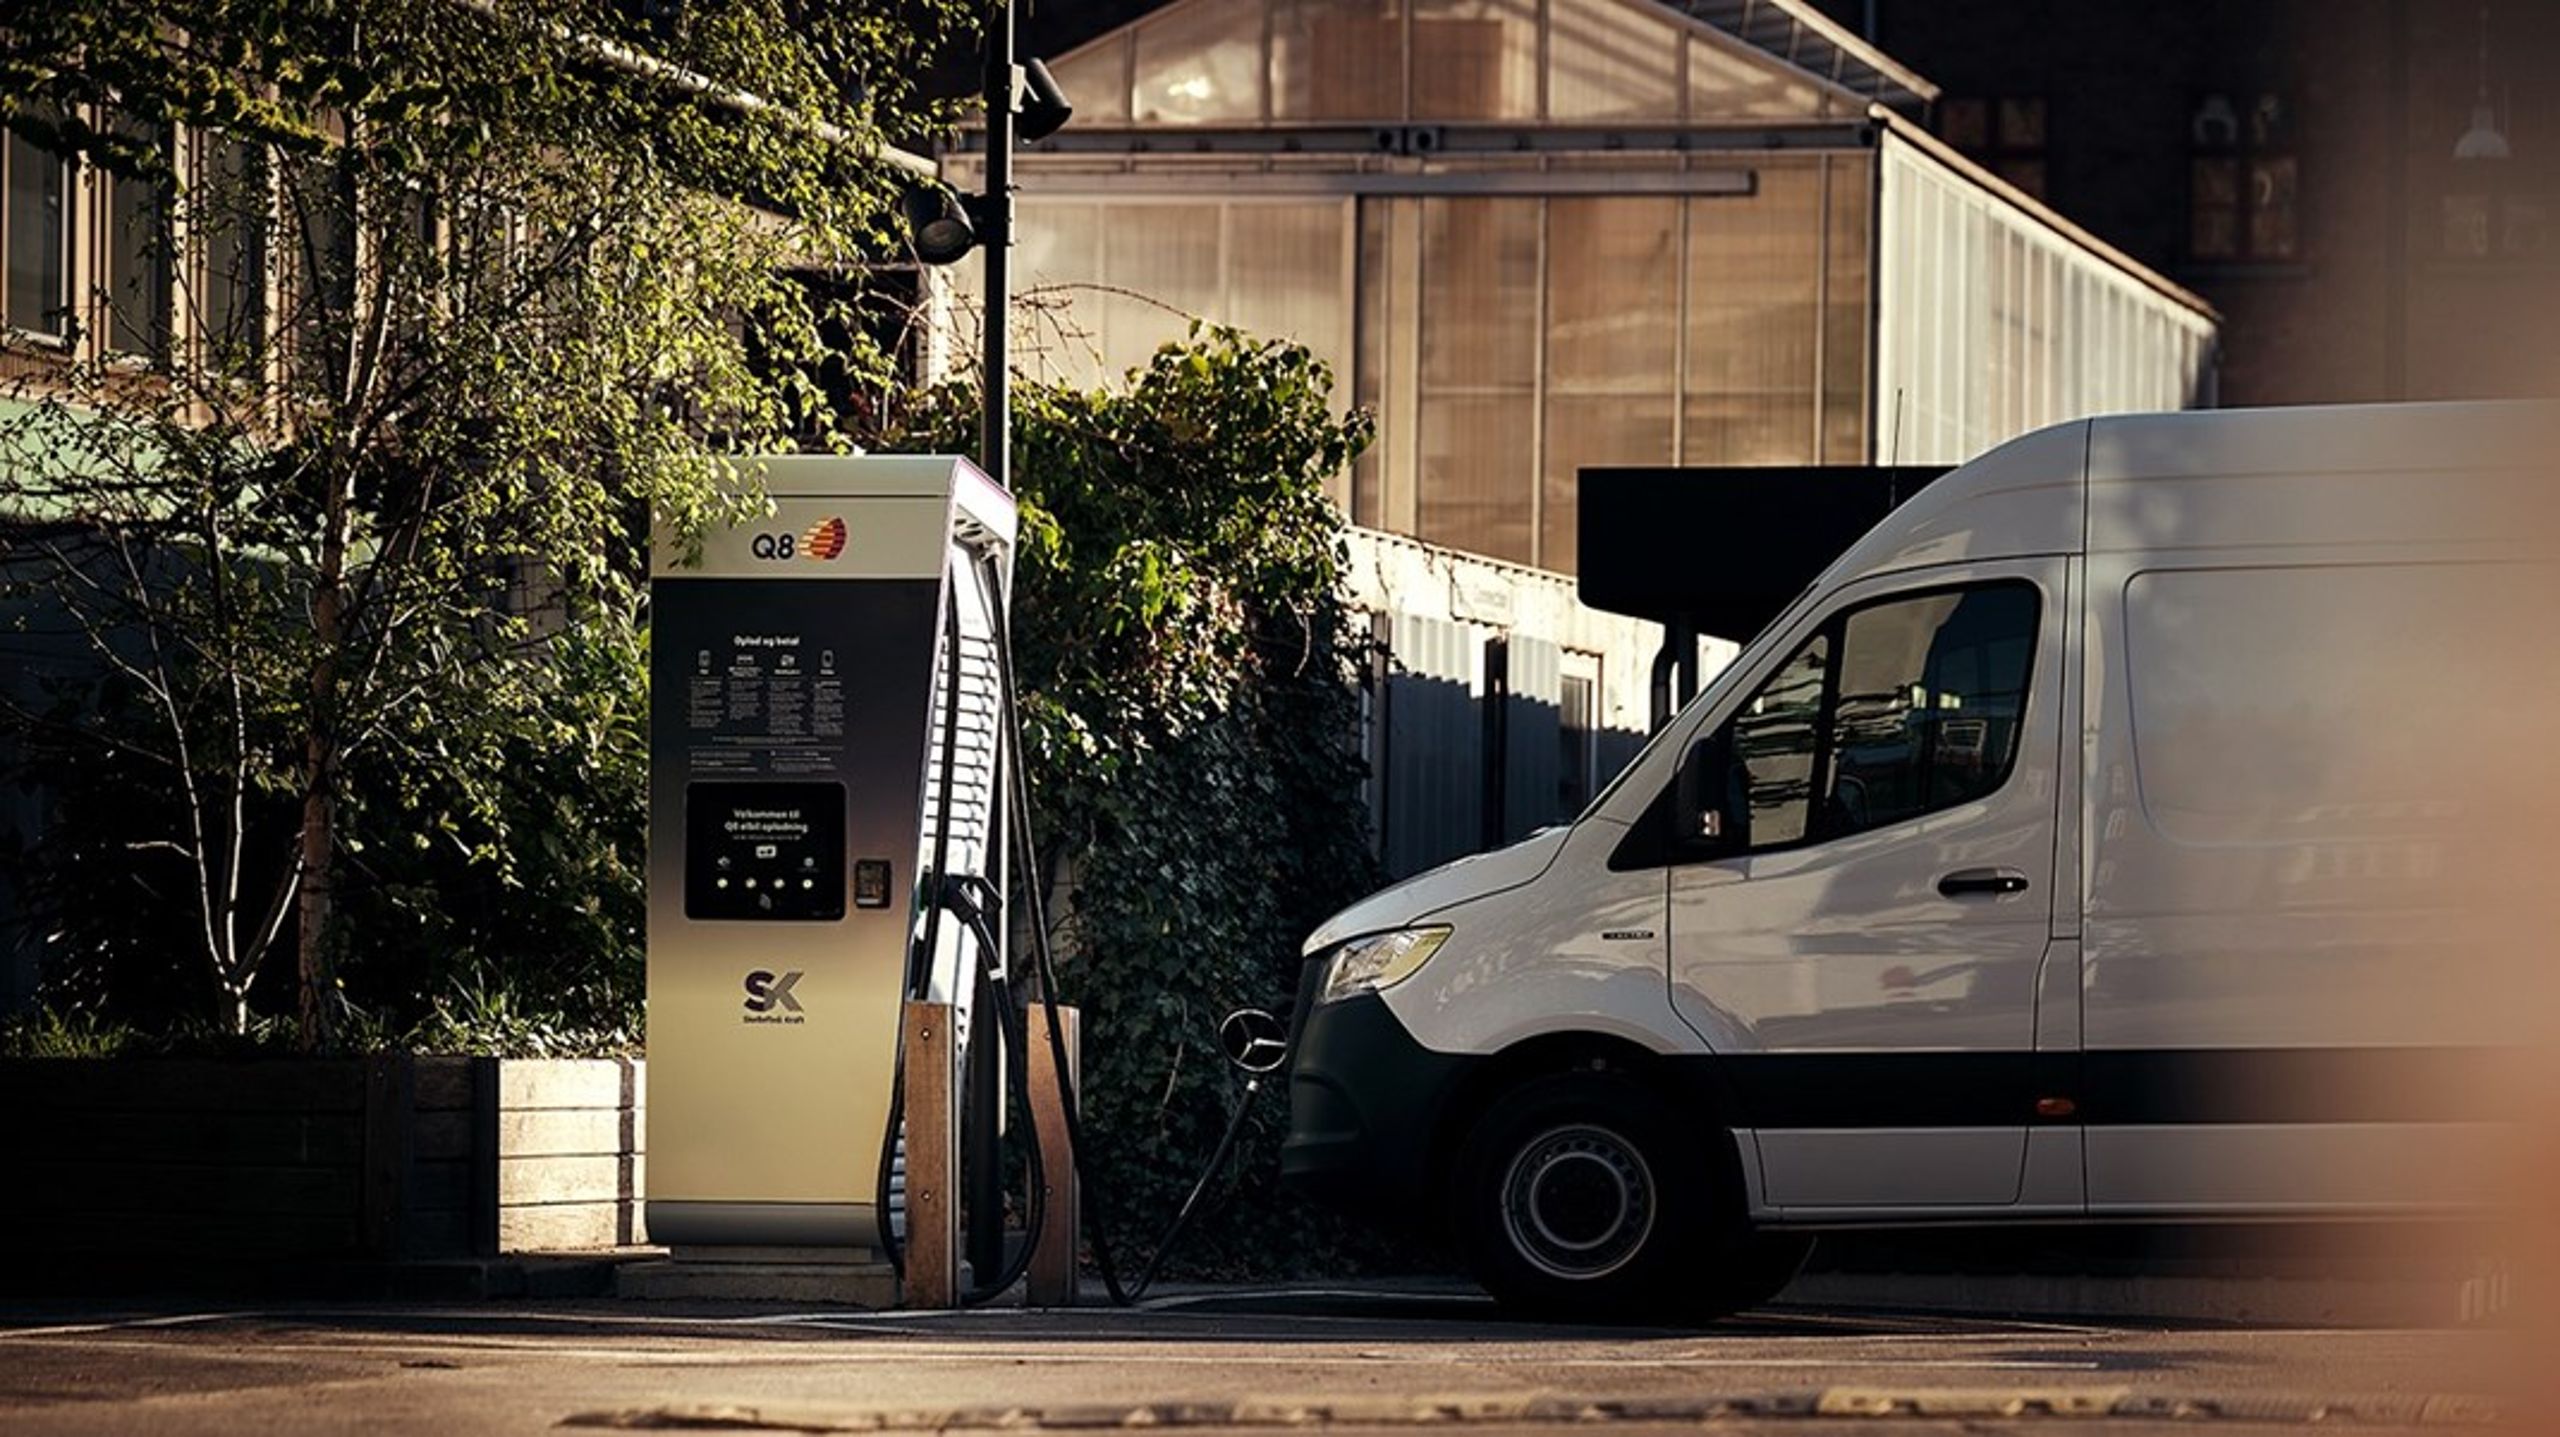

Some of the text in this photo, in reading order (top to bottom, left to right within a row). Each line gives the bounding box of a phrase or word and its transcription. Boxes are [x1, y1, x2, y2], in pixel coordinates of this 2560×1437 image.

[752, 533, 795, 560] Q8
[733, 808, 800, 819] Velkommen til
[744, 971, 804, 1012] SK
